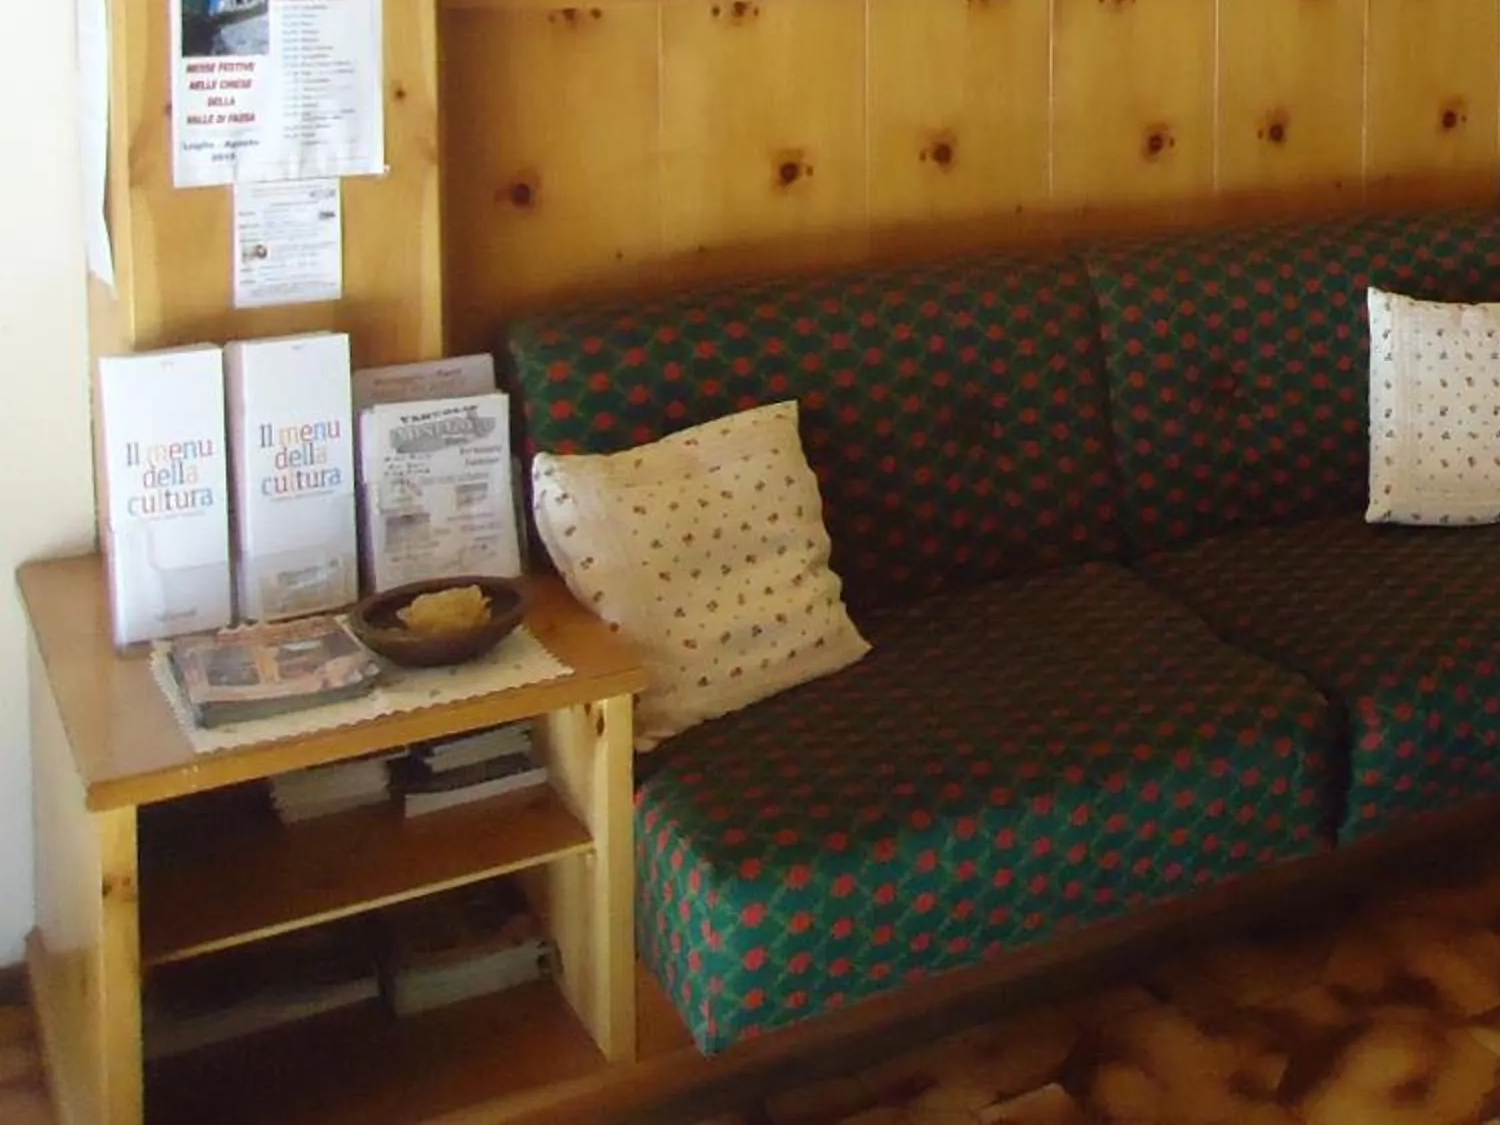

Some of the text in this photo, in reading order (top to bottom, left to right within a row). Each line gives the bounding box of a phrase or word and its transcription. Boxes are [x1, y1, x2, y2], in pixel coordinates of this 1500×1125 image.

[259, 420, 342, 448] Il menu
[126, 438, 214, 467] Il menu
[274, 442, 327, 470] della
[143, 461, 200, 490] della
[261, 467, 342, 496] cultura
[127, 487, 215, 517] cultura
